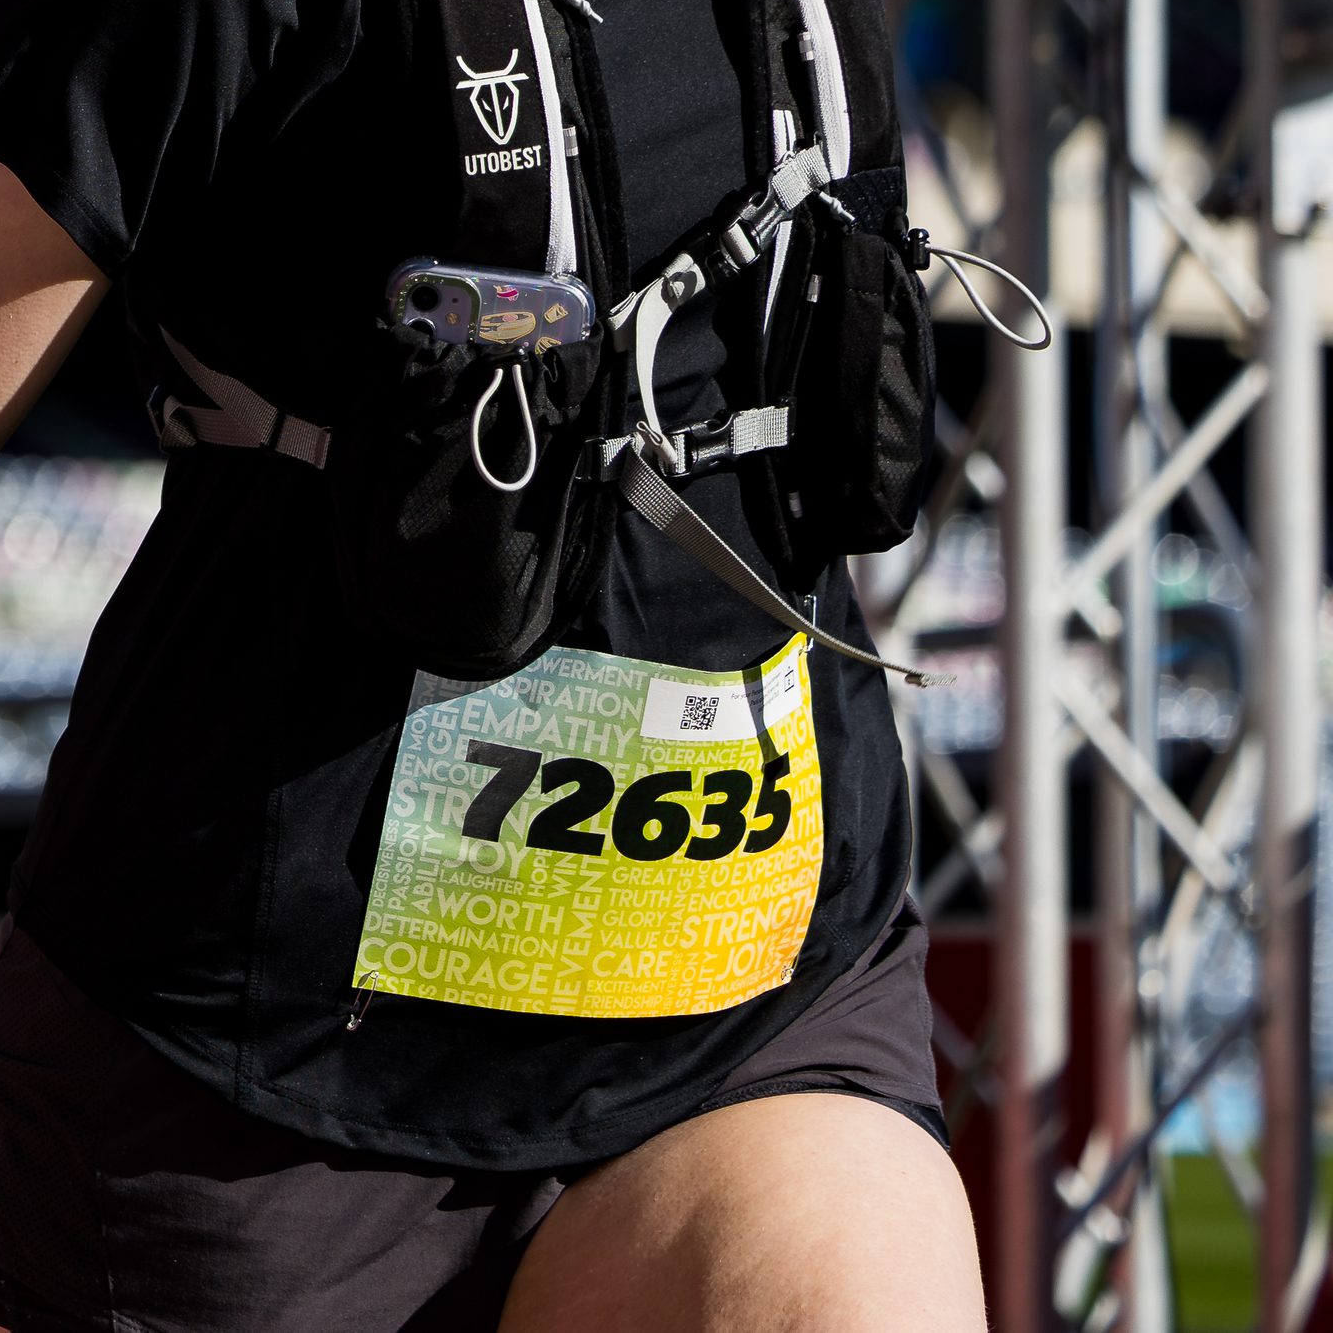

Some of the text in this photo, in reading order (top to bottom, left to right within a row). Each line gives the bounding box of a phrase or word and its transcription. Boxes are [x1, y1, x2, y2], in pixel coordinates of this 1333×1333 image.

[465, 145, 542, 175] UTOBEST
[460, 697, 638, 759] EMPATHY
[641, 743, 741, 766] TOLERANCE
[462, 739, 791, 862] 72635
[373, 819, 400, 908] DECISIVENESS
[388, 822, 420, 912] PASSION
[412, 823, 445, 915] ABILITY
[442, 835, 532, 880] JOY
[613, 866, 678, 887] GREAT
[439, 868, 525, 896] LAUGHTER
[608, 888, 673, 908] TRUTH
[436, 887, 565, 936] WORTH
[602, 909, 668, 928] GLORY
[663, 866, 695, 949] CHANGE
[365, 910, 559, 959] DETERMINATION
[600, 929, 661, 949] VALUE
[358, 937, 554, 995] COURAGE
[593, 950, 674, 979] CARE
[715, 936, 769, 981] JOY
[582, 995, 664, 1011] FRIENDSHIP
[586, 979, 671, 994] EXCITEMENT
